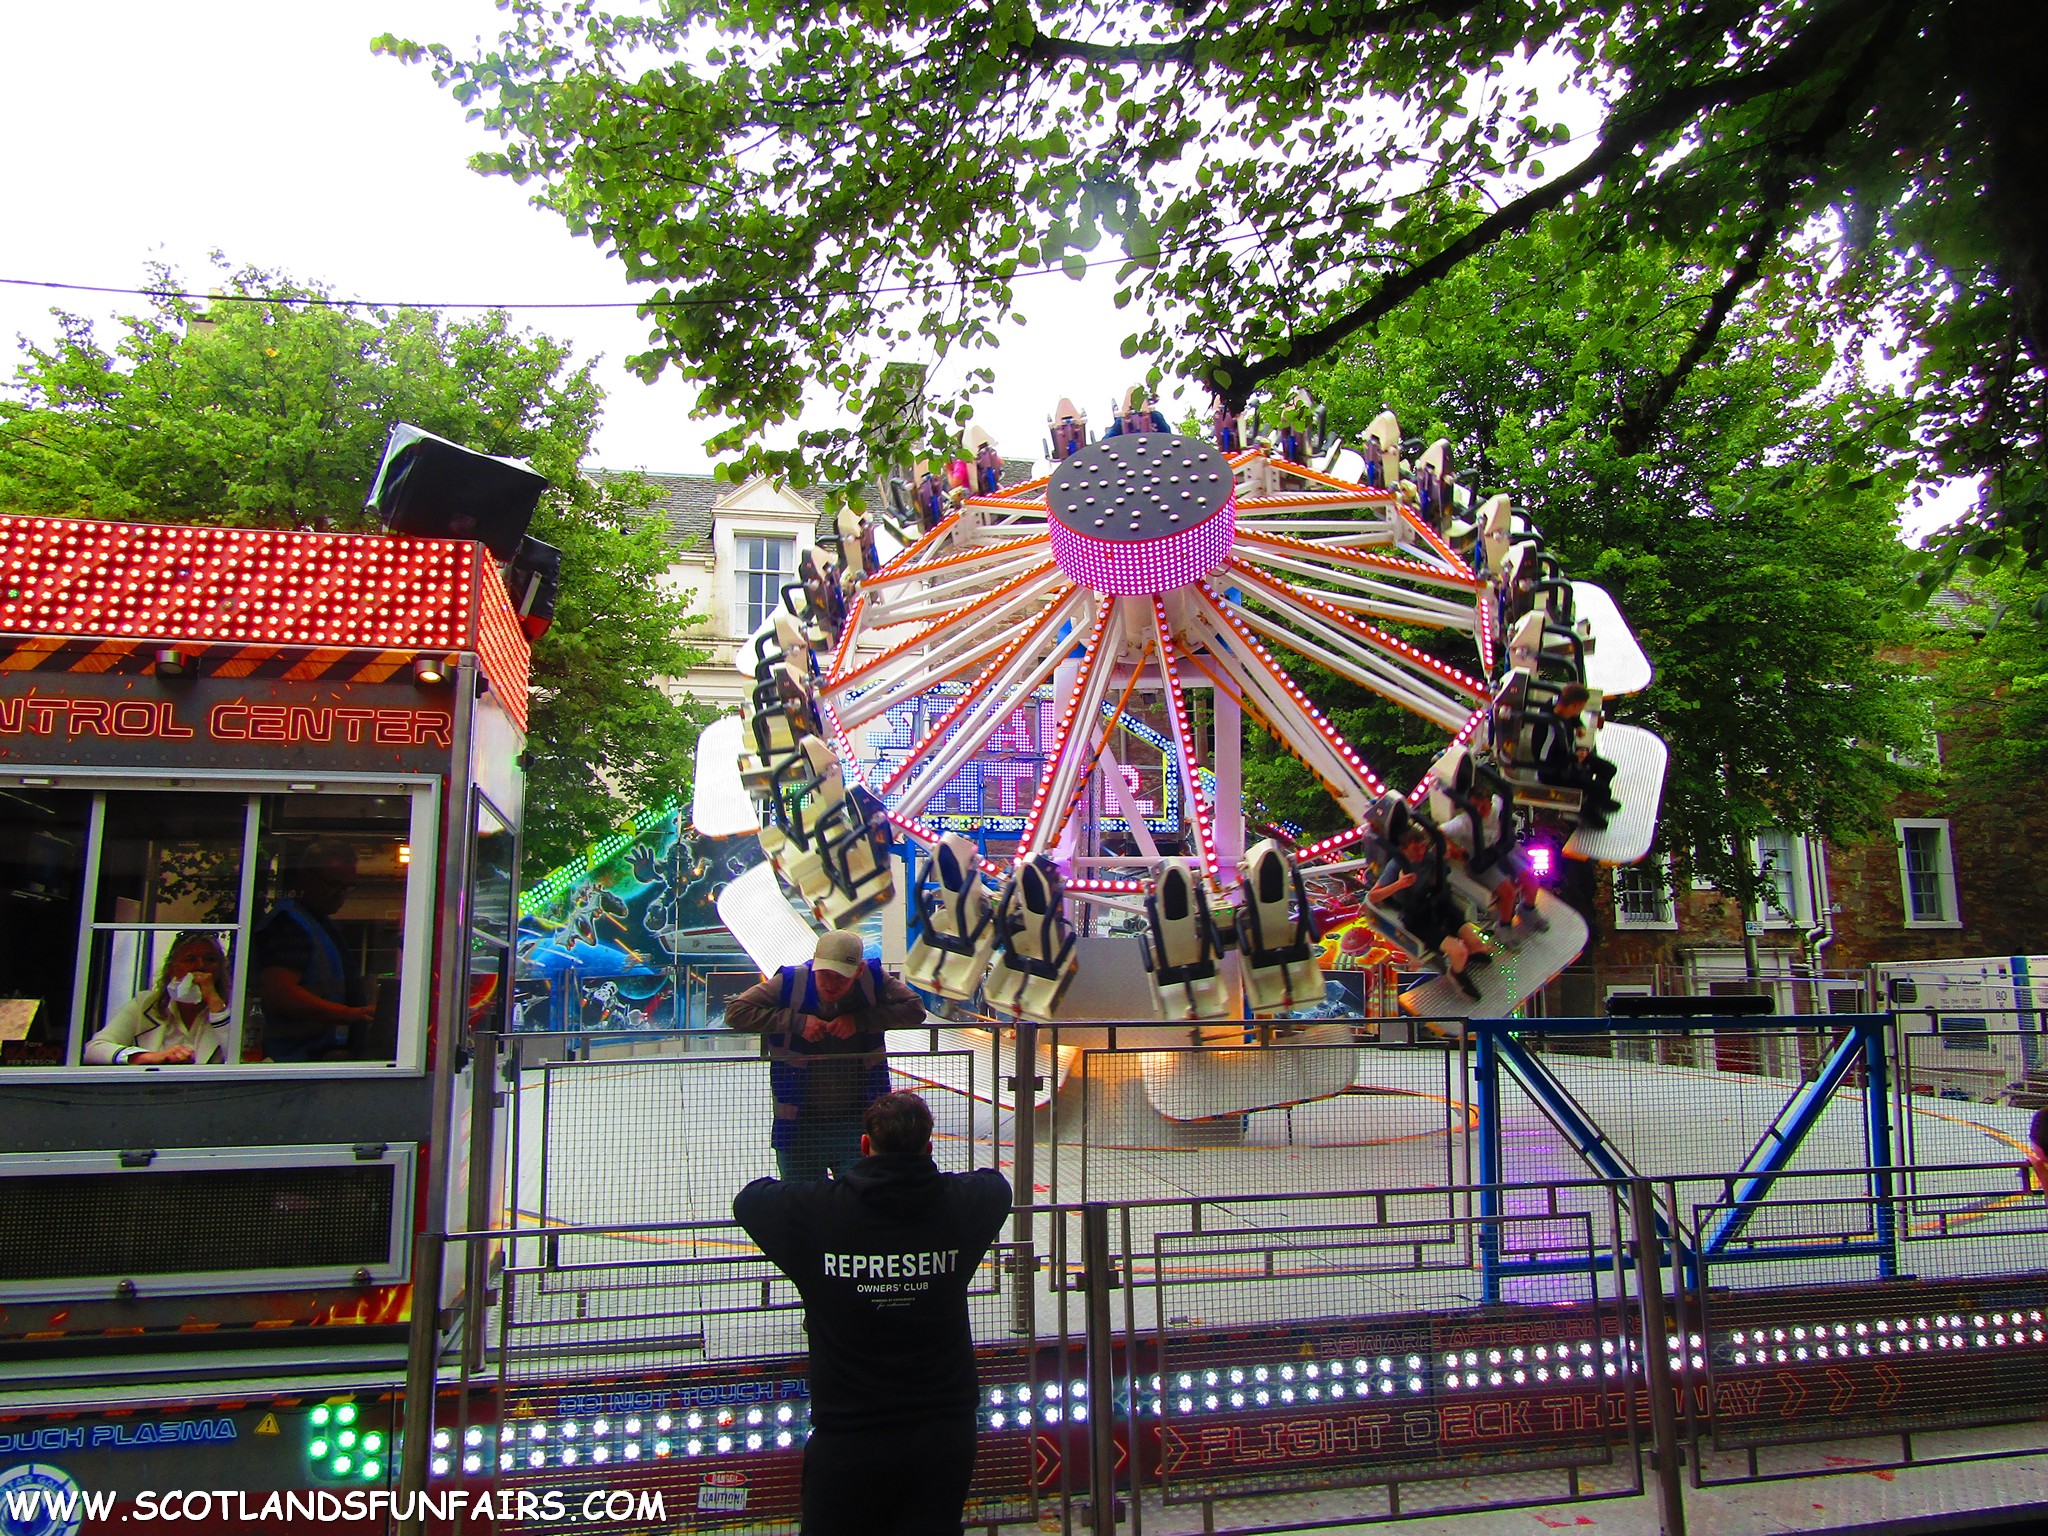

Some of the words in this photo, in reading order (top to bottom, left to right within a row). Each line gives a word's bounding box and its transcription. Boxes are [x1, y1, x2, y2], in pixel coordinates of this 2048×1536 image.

[210, 704, 452, 745] CENTER
[824, 1249, 959, 1279] REPRESENT
[857, 1283, 901, 1293] OWNERS'
[903, 1281, 929, 1291] CLUB
[1320, 1327, 1442, 1358] BEWARE
[558, 1395, 602, 1416] DO
[609, 1389, 672, 1412] NOT
[677, 1379, 775, 1406] TOUCH
[92, 1418, 238, 1447] PLASMA
[1201, 1413, 1391, 1465] FLIGHT
[1403, 1400, 1534, 1447] DECK
